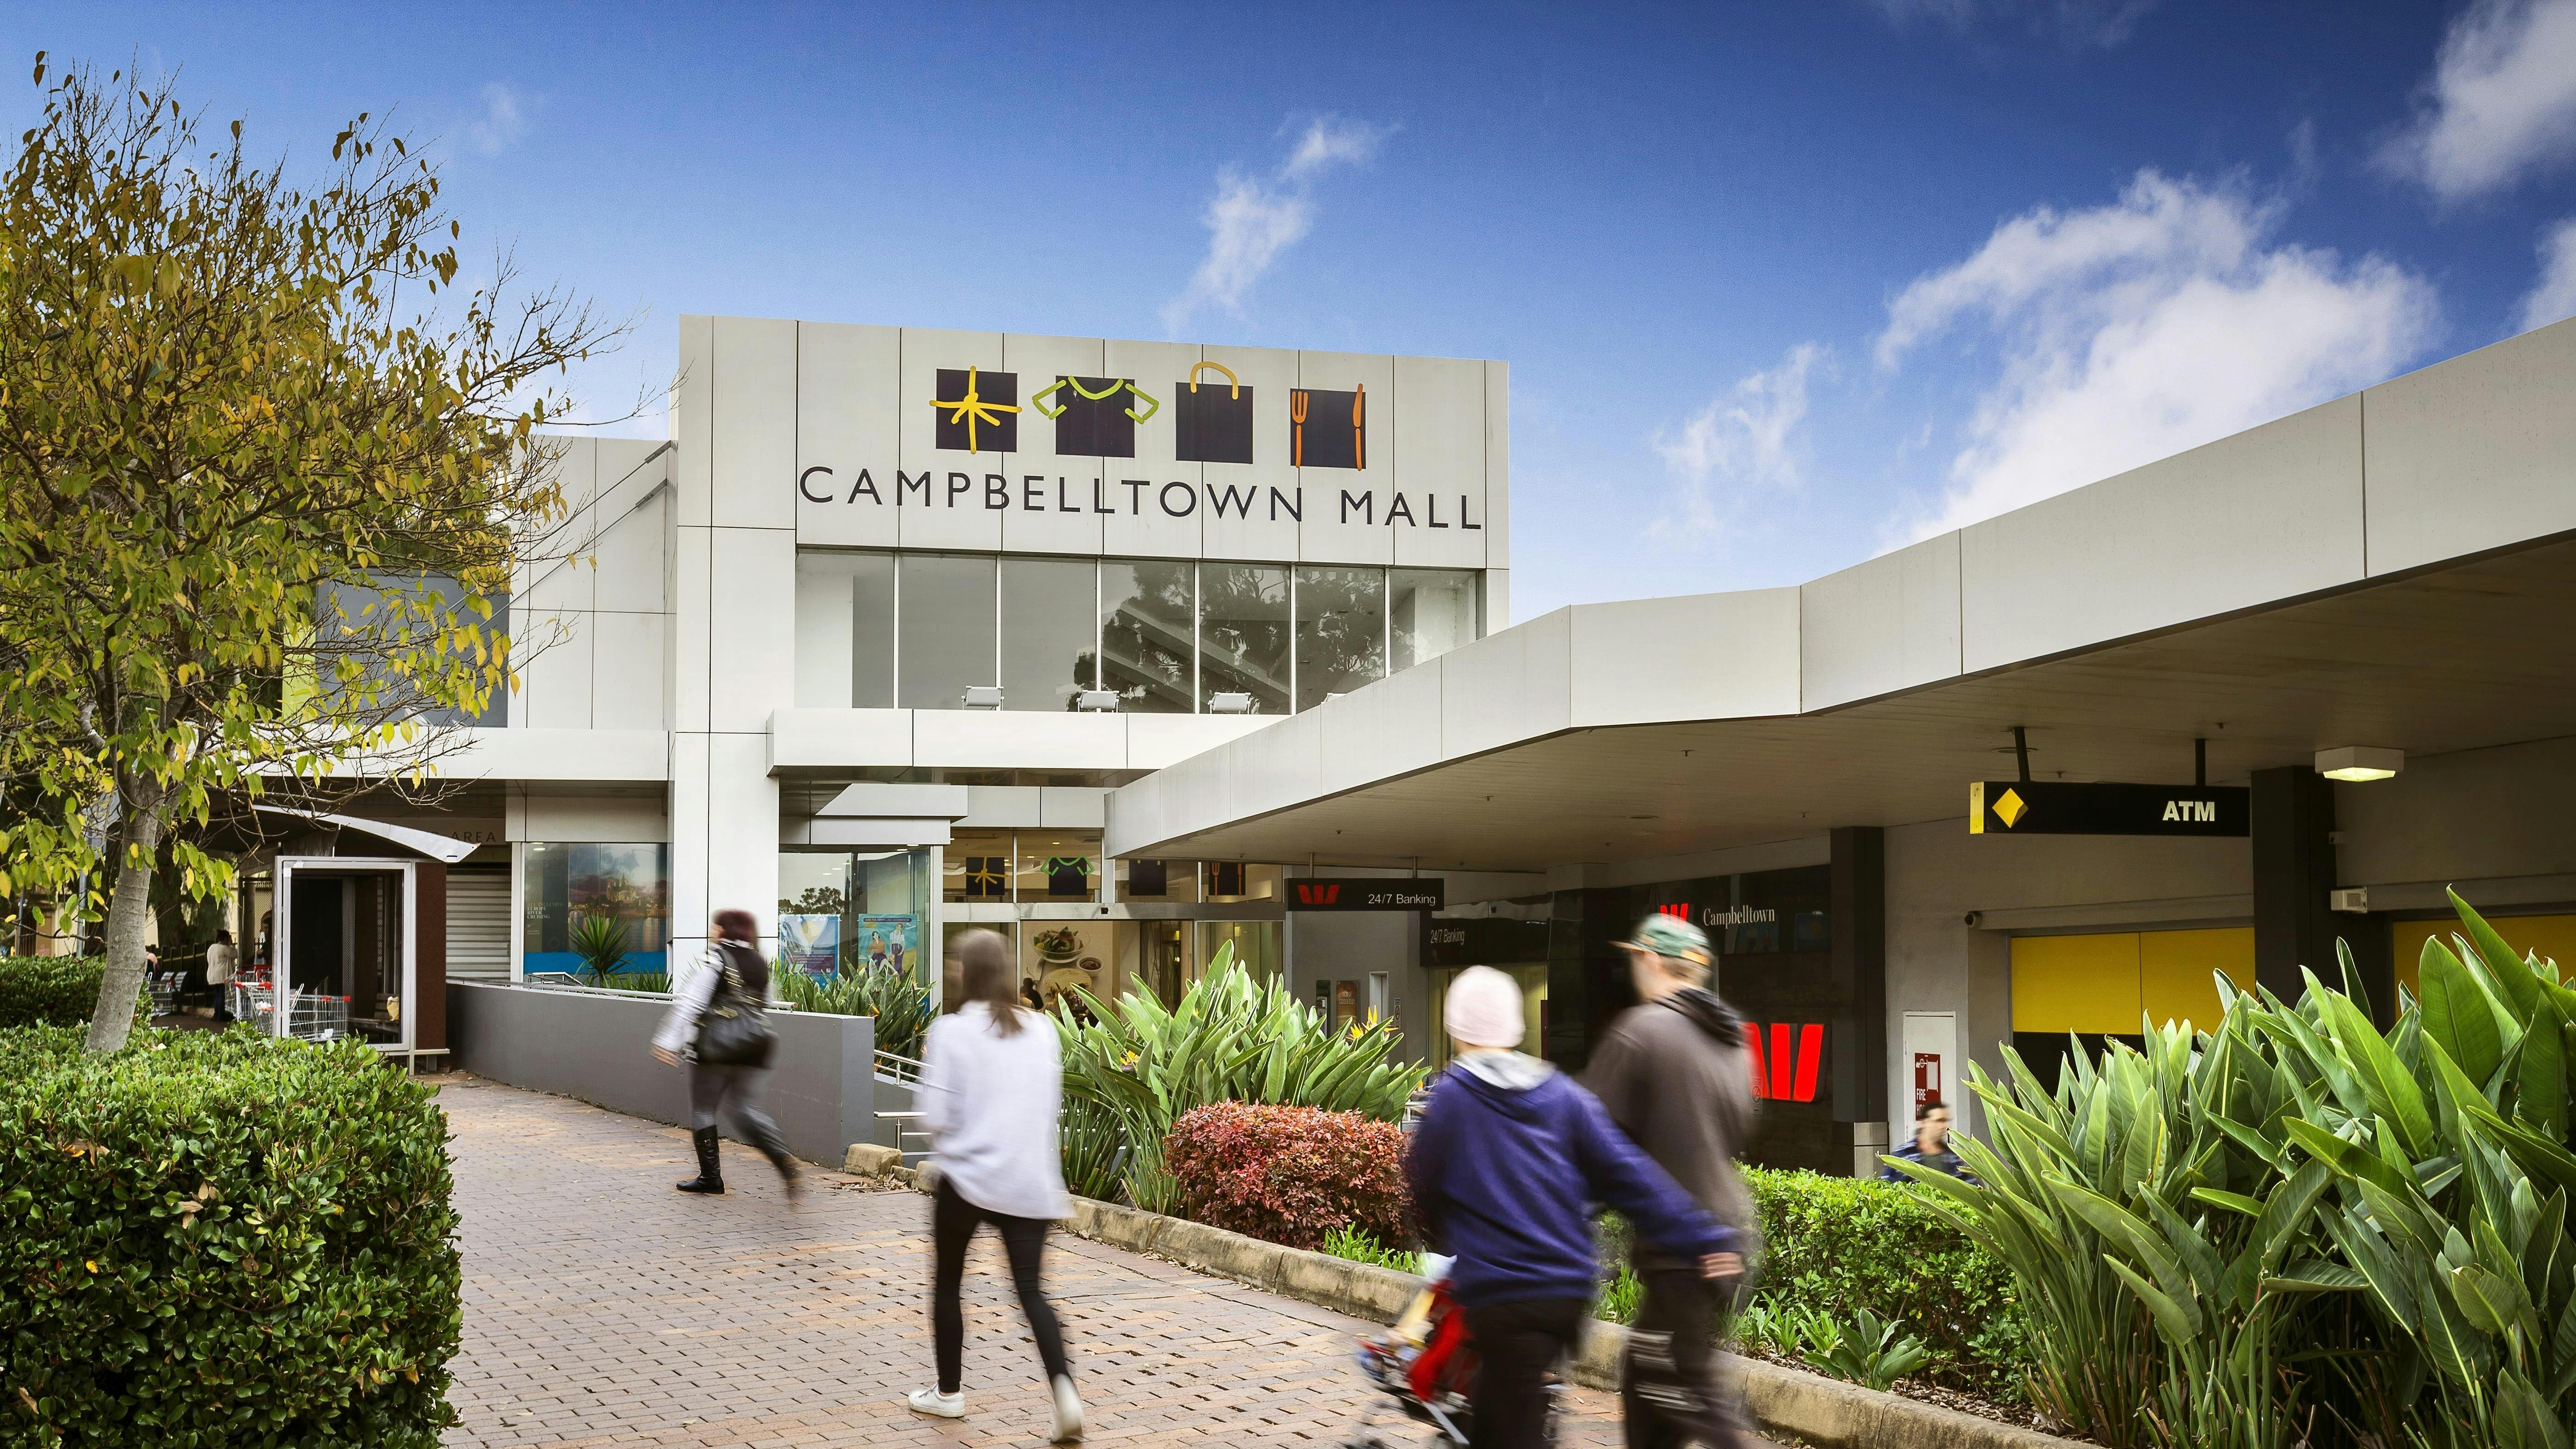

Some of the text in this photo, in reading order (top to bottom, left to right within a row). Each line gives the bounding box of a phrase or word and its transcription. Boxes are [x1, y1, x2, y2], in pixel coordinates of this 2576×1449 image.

[799, 466, 1482, 530] CAMPBELLTOWN MALL
[2162, 801, 2215, 822] ATM
[452, 832, 496, 843] AREA
[1368, 894, 1436, 906] 24/7 Banking
[1703, 905, 1775, 929] Campbelltown
[1431, 928, 1465, 945] 24/7 Banking
[1916, 1088, 1926, 1101] FIRE
[1916, 1104, 1925, 1116] HO
